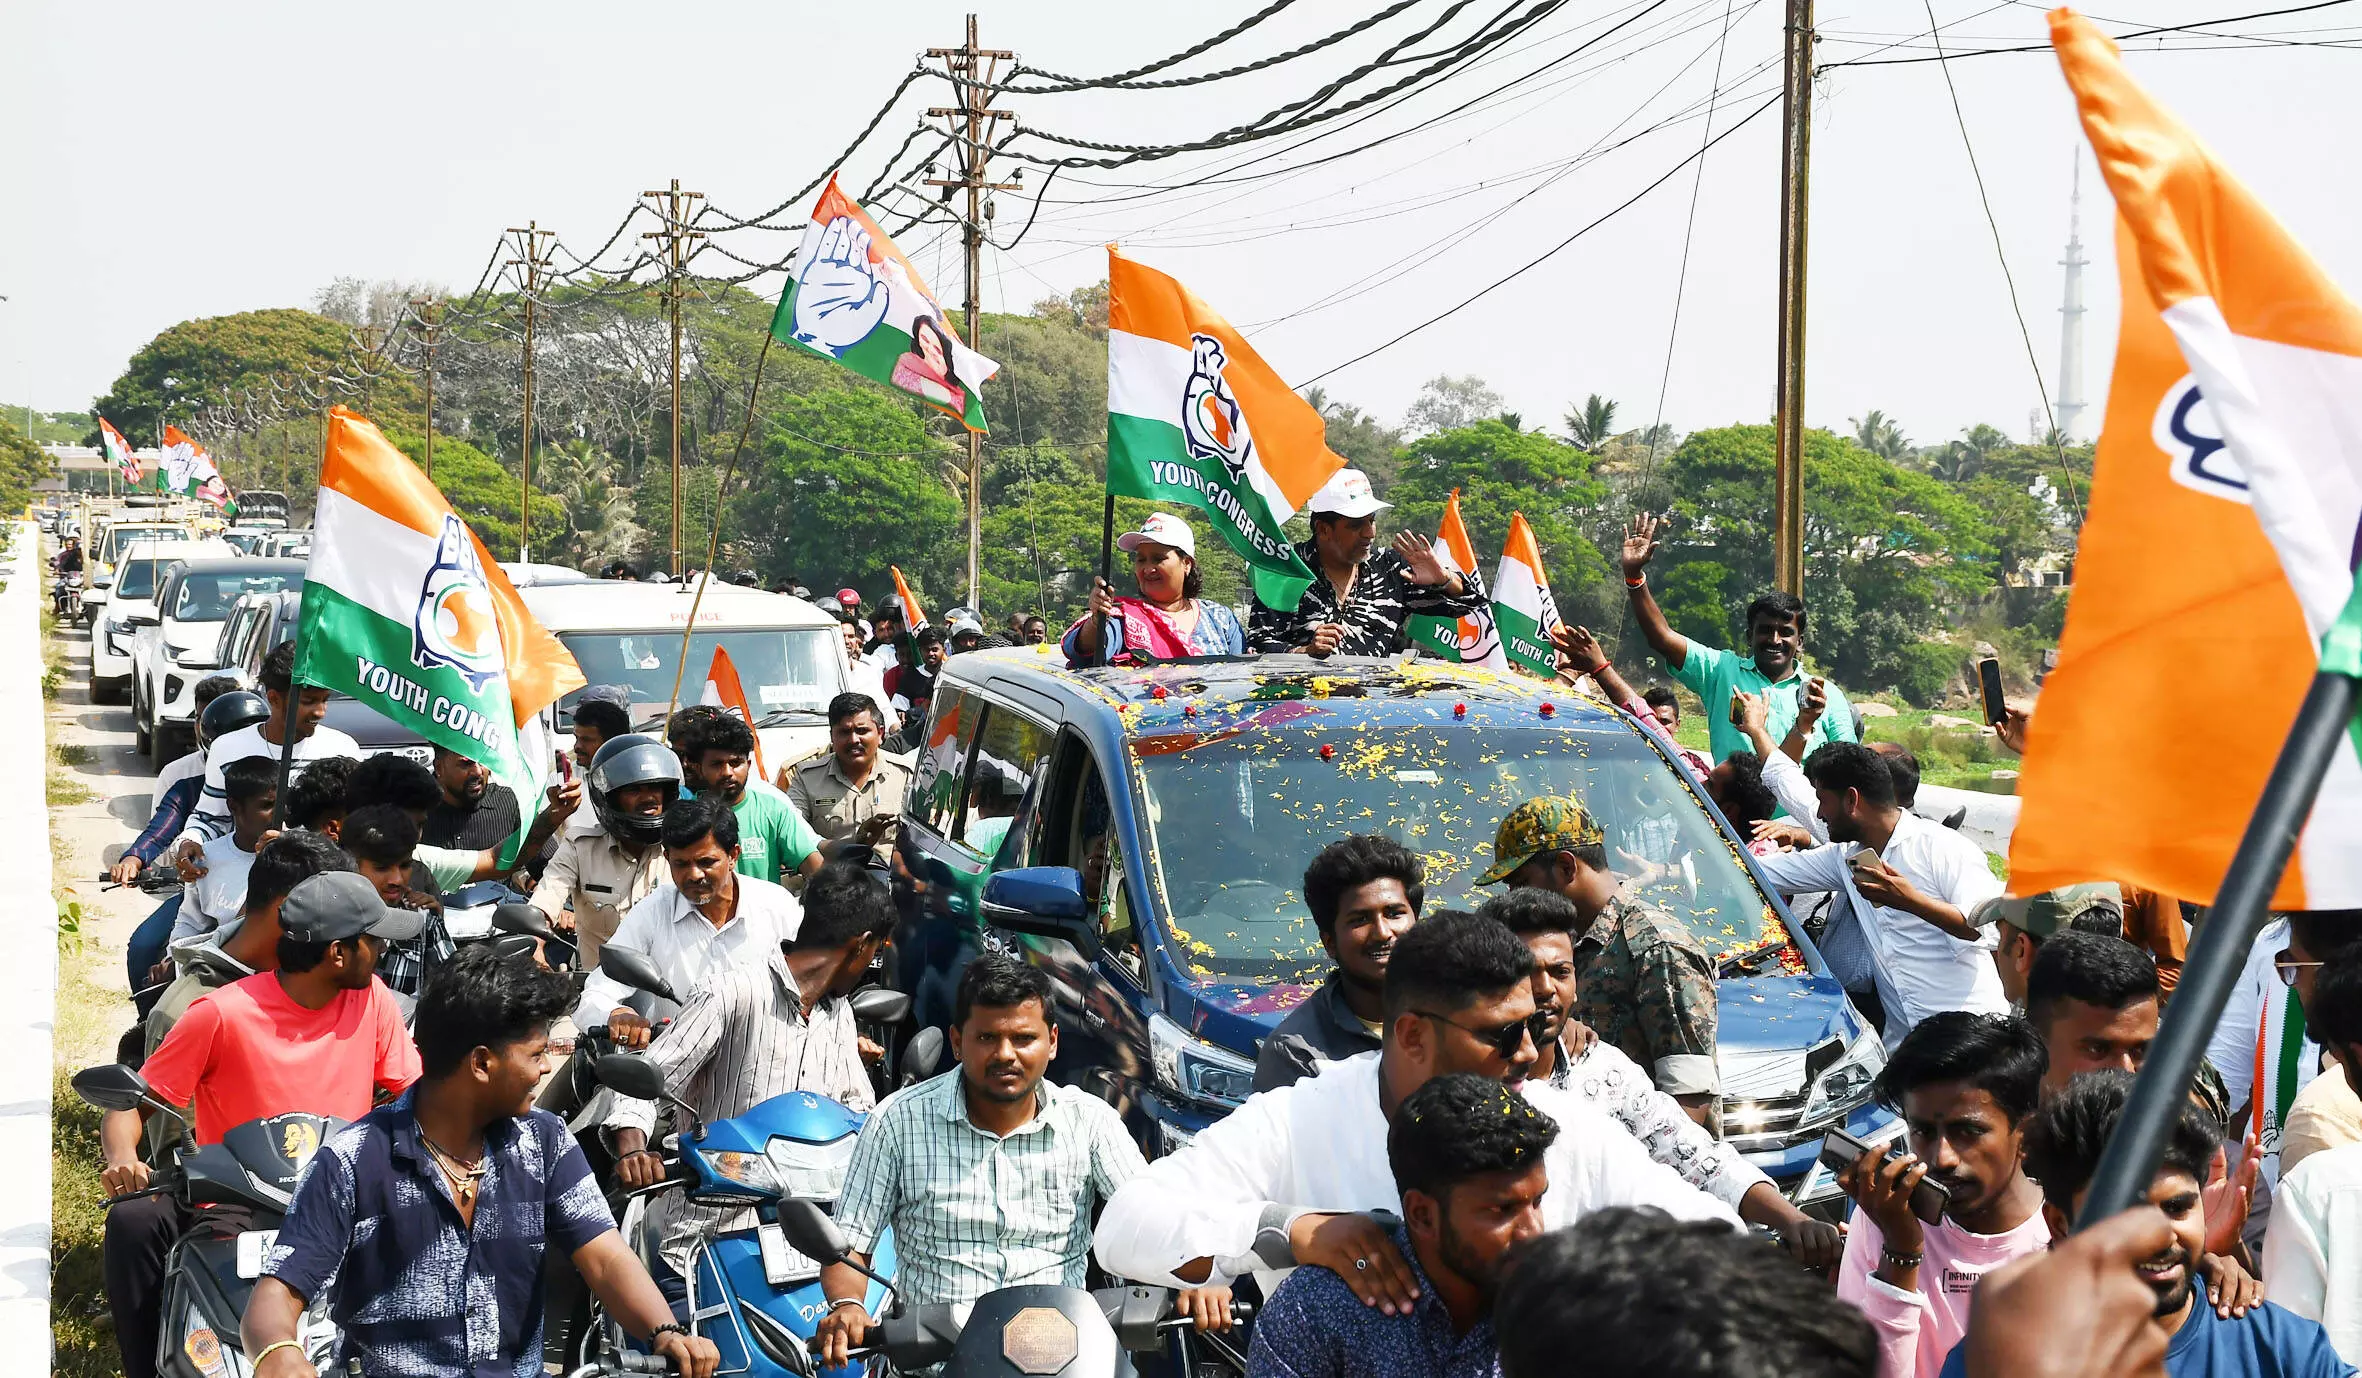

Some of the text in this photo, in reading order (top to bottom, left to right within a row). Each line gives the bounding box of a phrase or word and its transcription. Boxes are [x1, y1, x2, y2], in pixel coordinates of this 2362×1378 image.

[1206, 481, 1291, 561] CONGRESS
[1510, 636, 1543, 662] YOUTH
[357, 656, 429, 715] YOUTH
